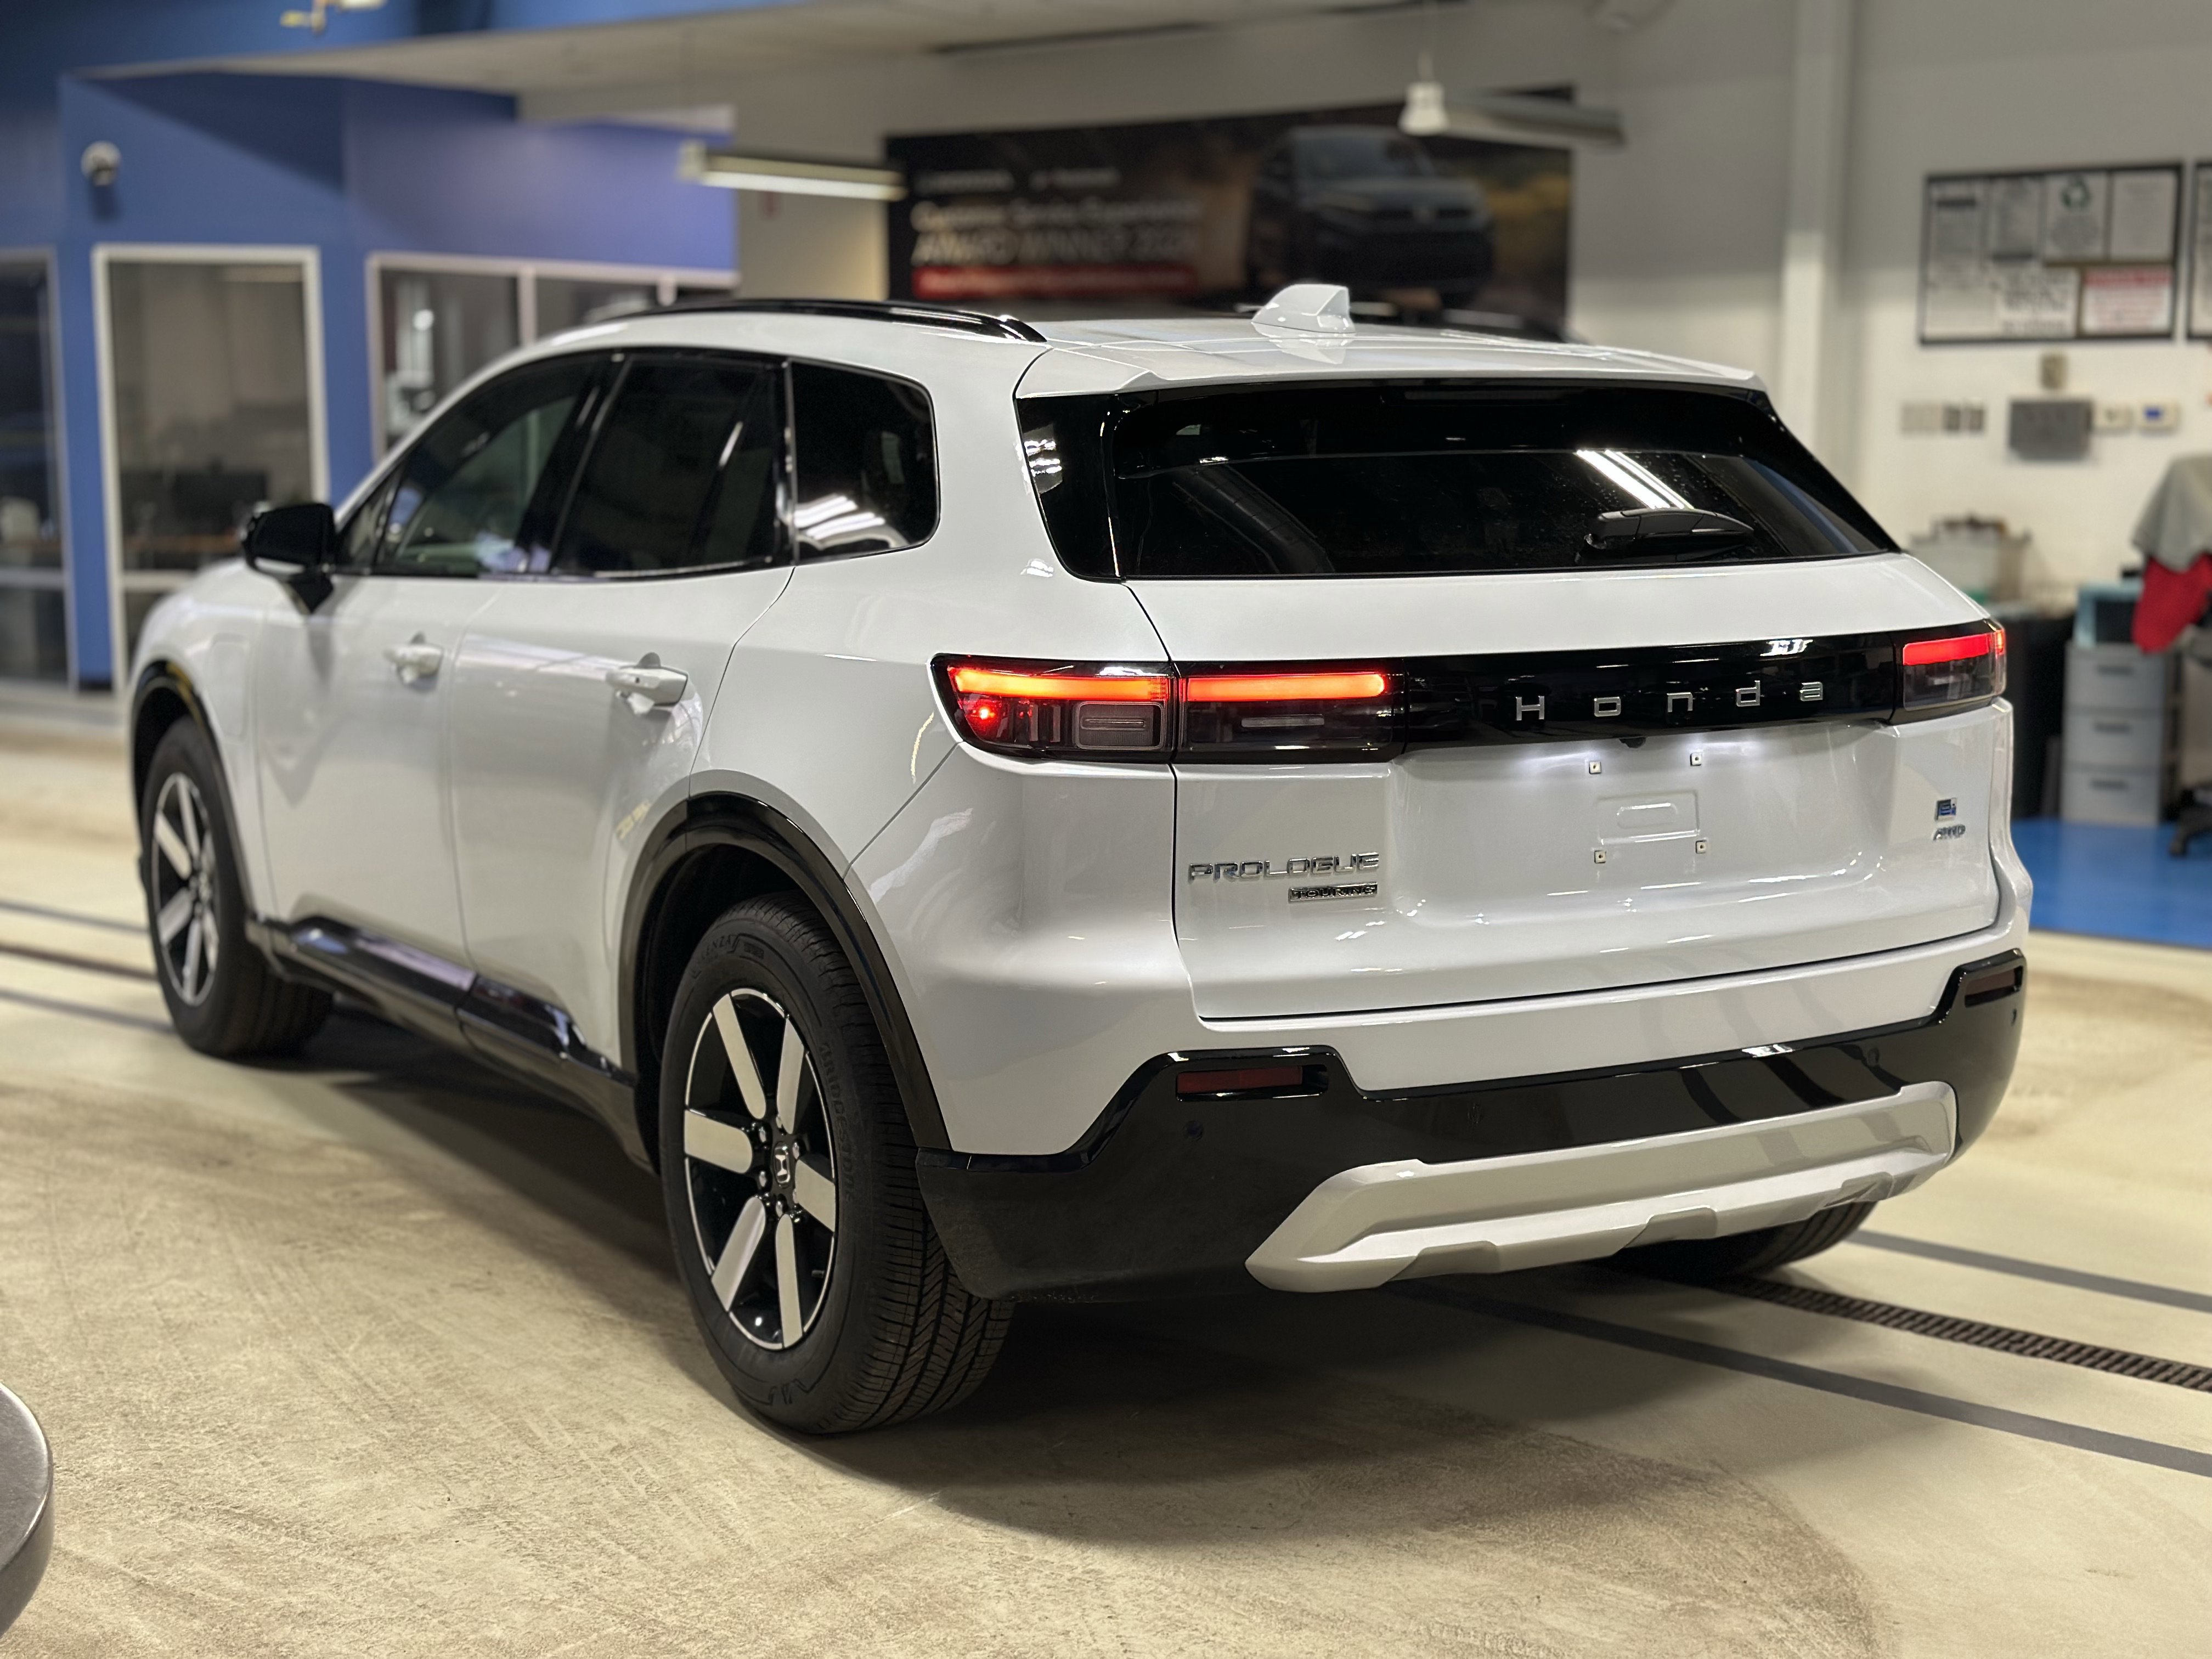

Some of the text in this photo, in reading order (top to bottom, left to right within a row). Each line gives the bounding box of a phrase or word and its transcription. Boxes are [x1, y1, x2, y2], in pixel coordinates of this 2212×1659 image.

[1933, 824, 1966, 840] AWD
[1188, 851, 1379, 883] PROLOGUE
[1291, 884, 1376, 899] TOURING
